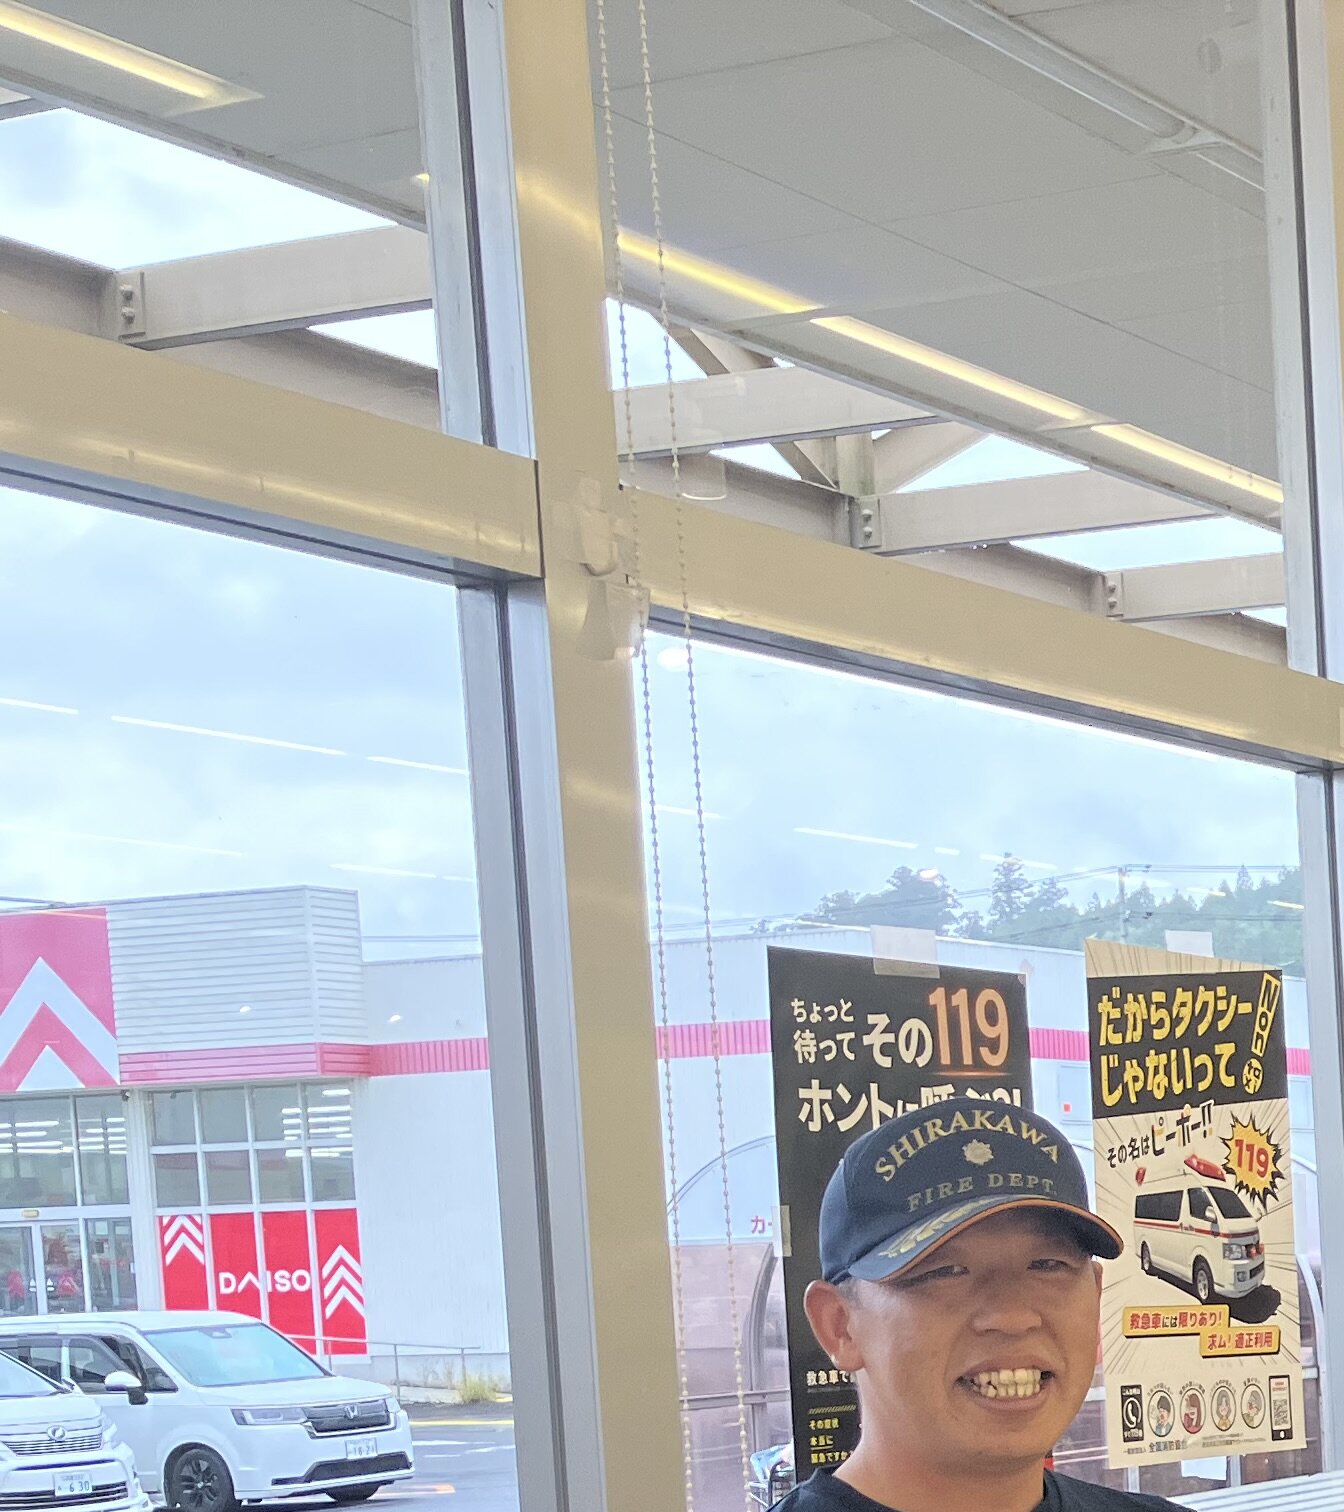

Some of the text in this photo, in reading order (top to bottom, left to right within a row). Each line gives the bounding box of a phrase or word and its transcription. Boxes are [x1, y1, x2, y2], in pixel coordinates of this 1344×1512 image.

[791, 998, 855, 1023] ちょっと
[863, 987, 1009, 1069] その119
[1098, 985, 1253, 1046] だからタクシー
[793, 1029, 856, 1064] 待って
[1101, 1042, 1236, 1107] じゃないって
[875, 1109, 1061, 1182] SHIRAKAWA
[1234, 1139, 1270, 1178] 119
[907, 1176, 974, 1213] FIRE
[219, 1269, 311, 1295] DAISO
[1130, 1310, 1223, 1330] 救急車には限りあり!
